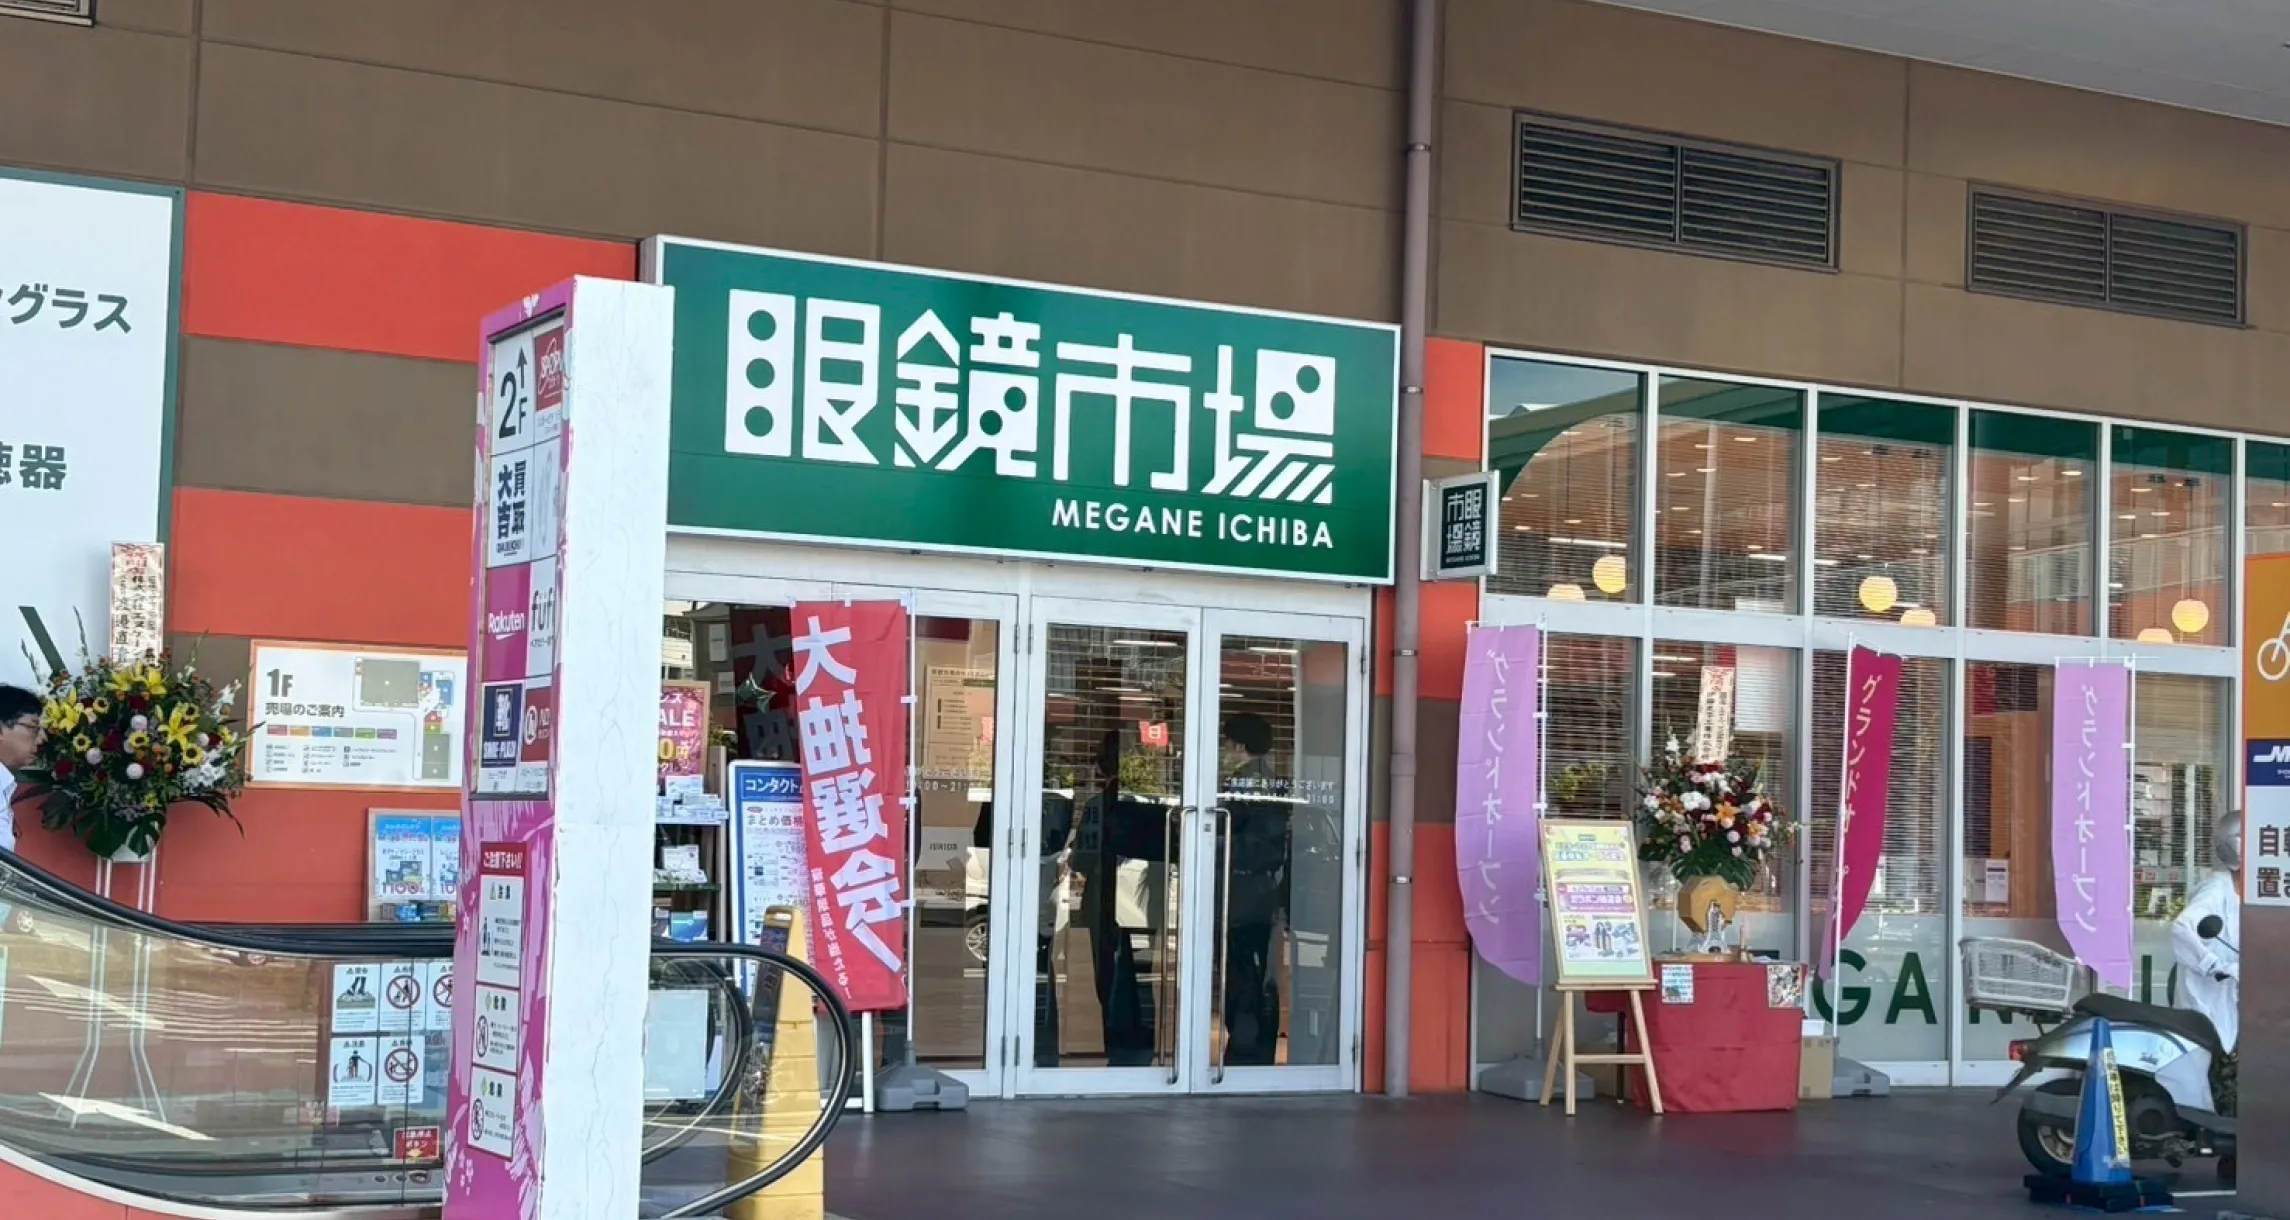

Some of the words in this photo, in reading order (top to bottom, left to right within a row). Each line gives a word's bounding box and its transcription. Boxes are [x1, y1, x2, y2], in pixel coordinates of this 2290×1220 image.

[0, 283, 132, 334] グラス
[499, 371, 528, 439] 2F
[724, 288, 1337, 504] 眼鏡市場
[1051, 498, 1203, 538] MEGANE
[1218, 513, 1335, 549] ICHIBA
[488, 609, 525, 635] Rakuten
[266, 668, 294, 697] 1F
[265, 702, 345, 718] 売場のご案内
